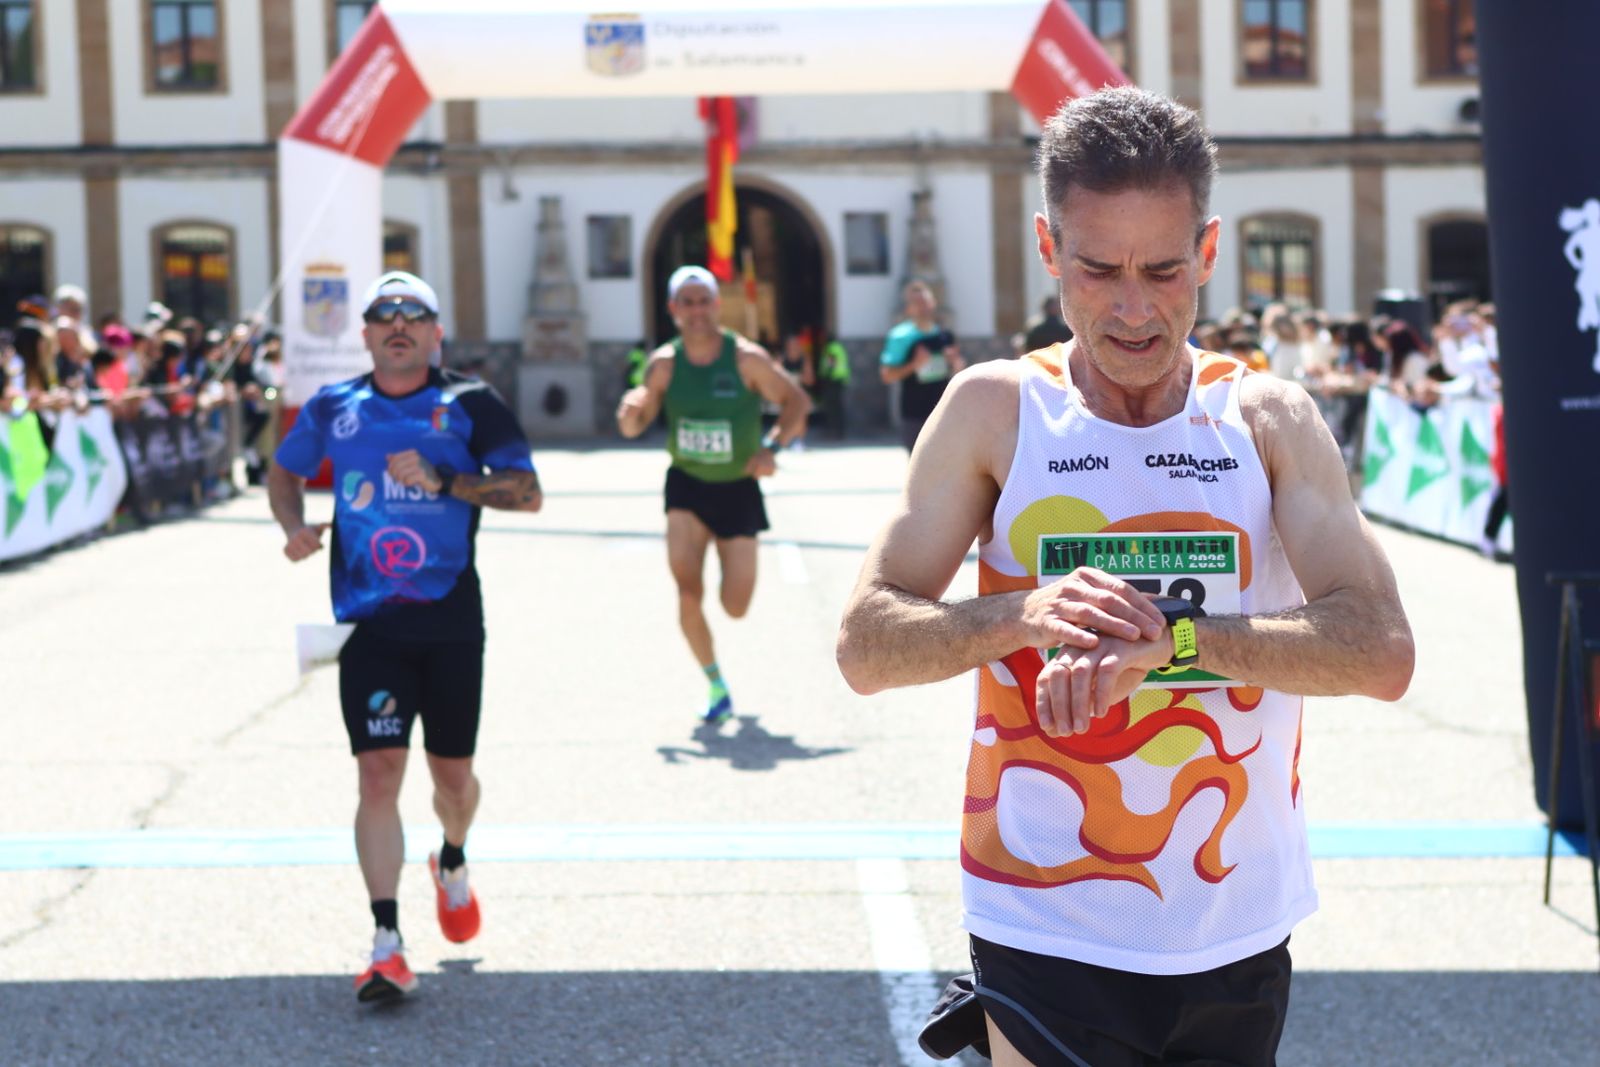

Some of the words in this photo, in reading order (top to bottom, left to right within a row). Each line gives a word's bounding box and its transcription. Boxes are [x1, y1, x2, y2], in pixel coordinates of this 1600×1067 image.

[1049, 454, 1109, 473] RAMÓN
[1169, 470, 1219, 482] SALANCA
[1045, 541, 1088, 569] XIV
[1094, 540, 1126, 554] SAN
[1142, 539, 1229, 554] FERNANDO
[1094, 554, 1184, 569] CARRERA
[367, 717, 403, 738] MSC
